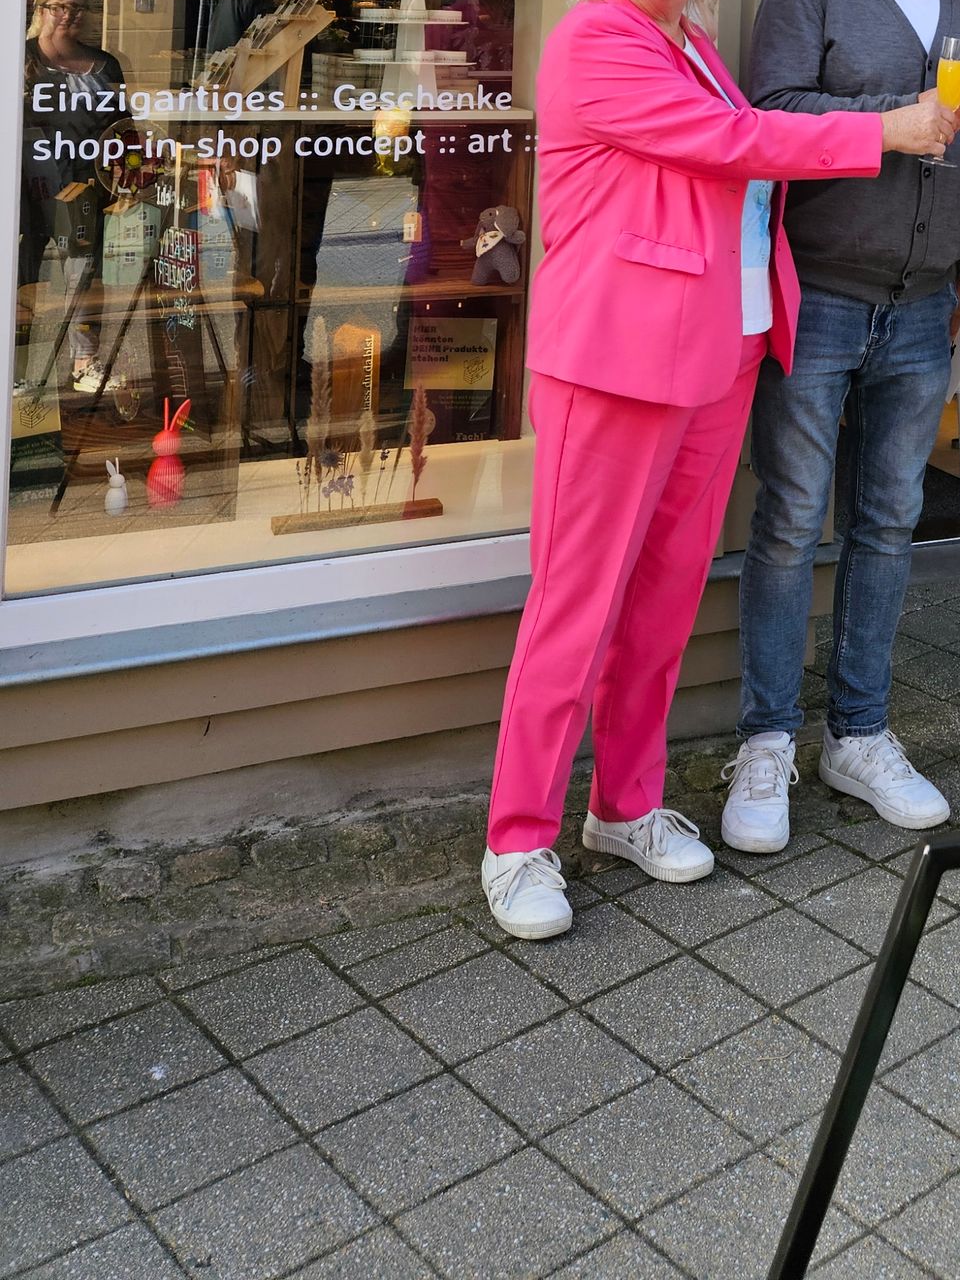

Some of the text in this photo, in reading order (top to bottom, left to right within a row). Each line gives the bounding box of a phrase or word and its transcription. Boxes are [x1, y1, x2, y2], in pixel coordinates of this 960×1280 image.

[32, 83, 285, 120] Einzigartiges
[333, 84, 513, 111] Geschenke
[32, 129, 282, 167] shop-in-shop
[294, 130, 426, 162] concept
[467, 128, 513, 153] art
[442, 345, 488, 353] Produkte
